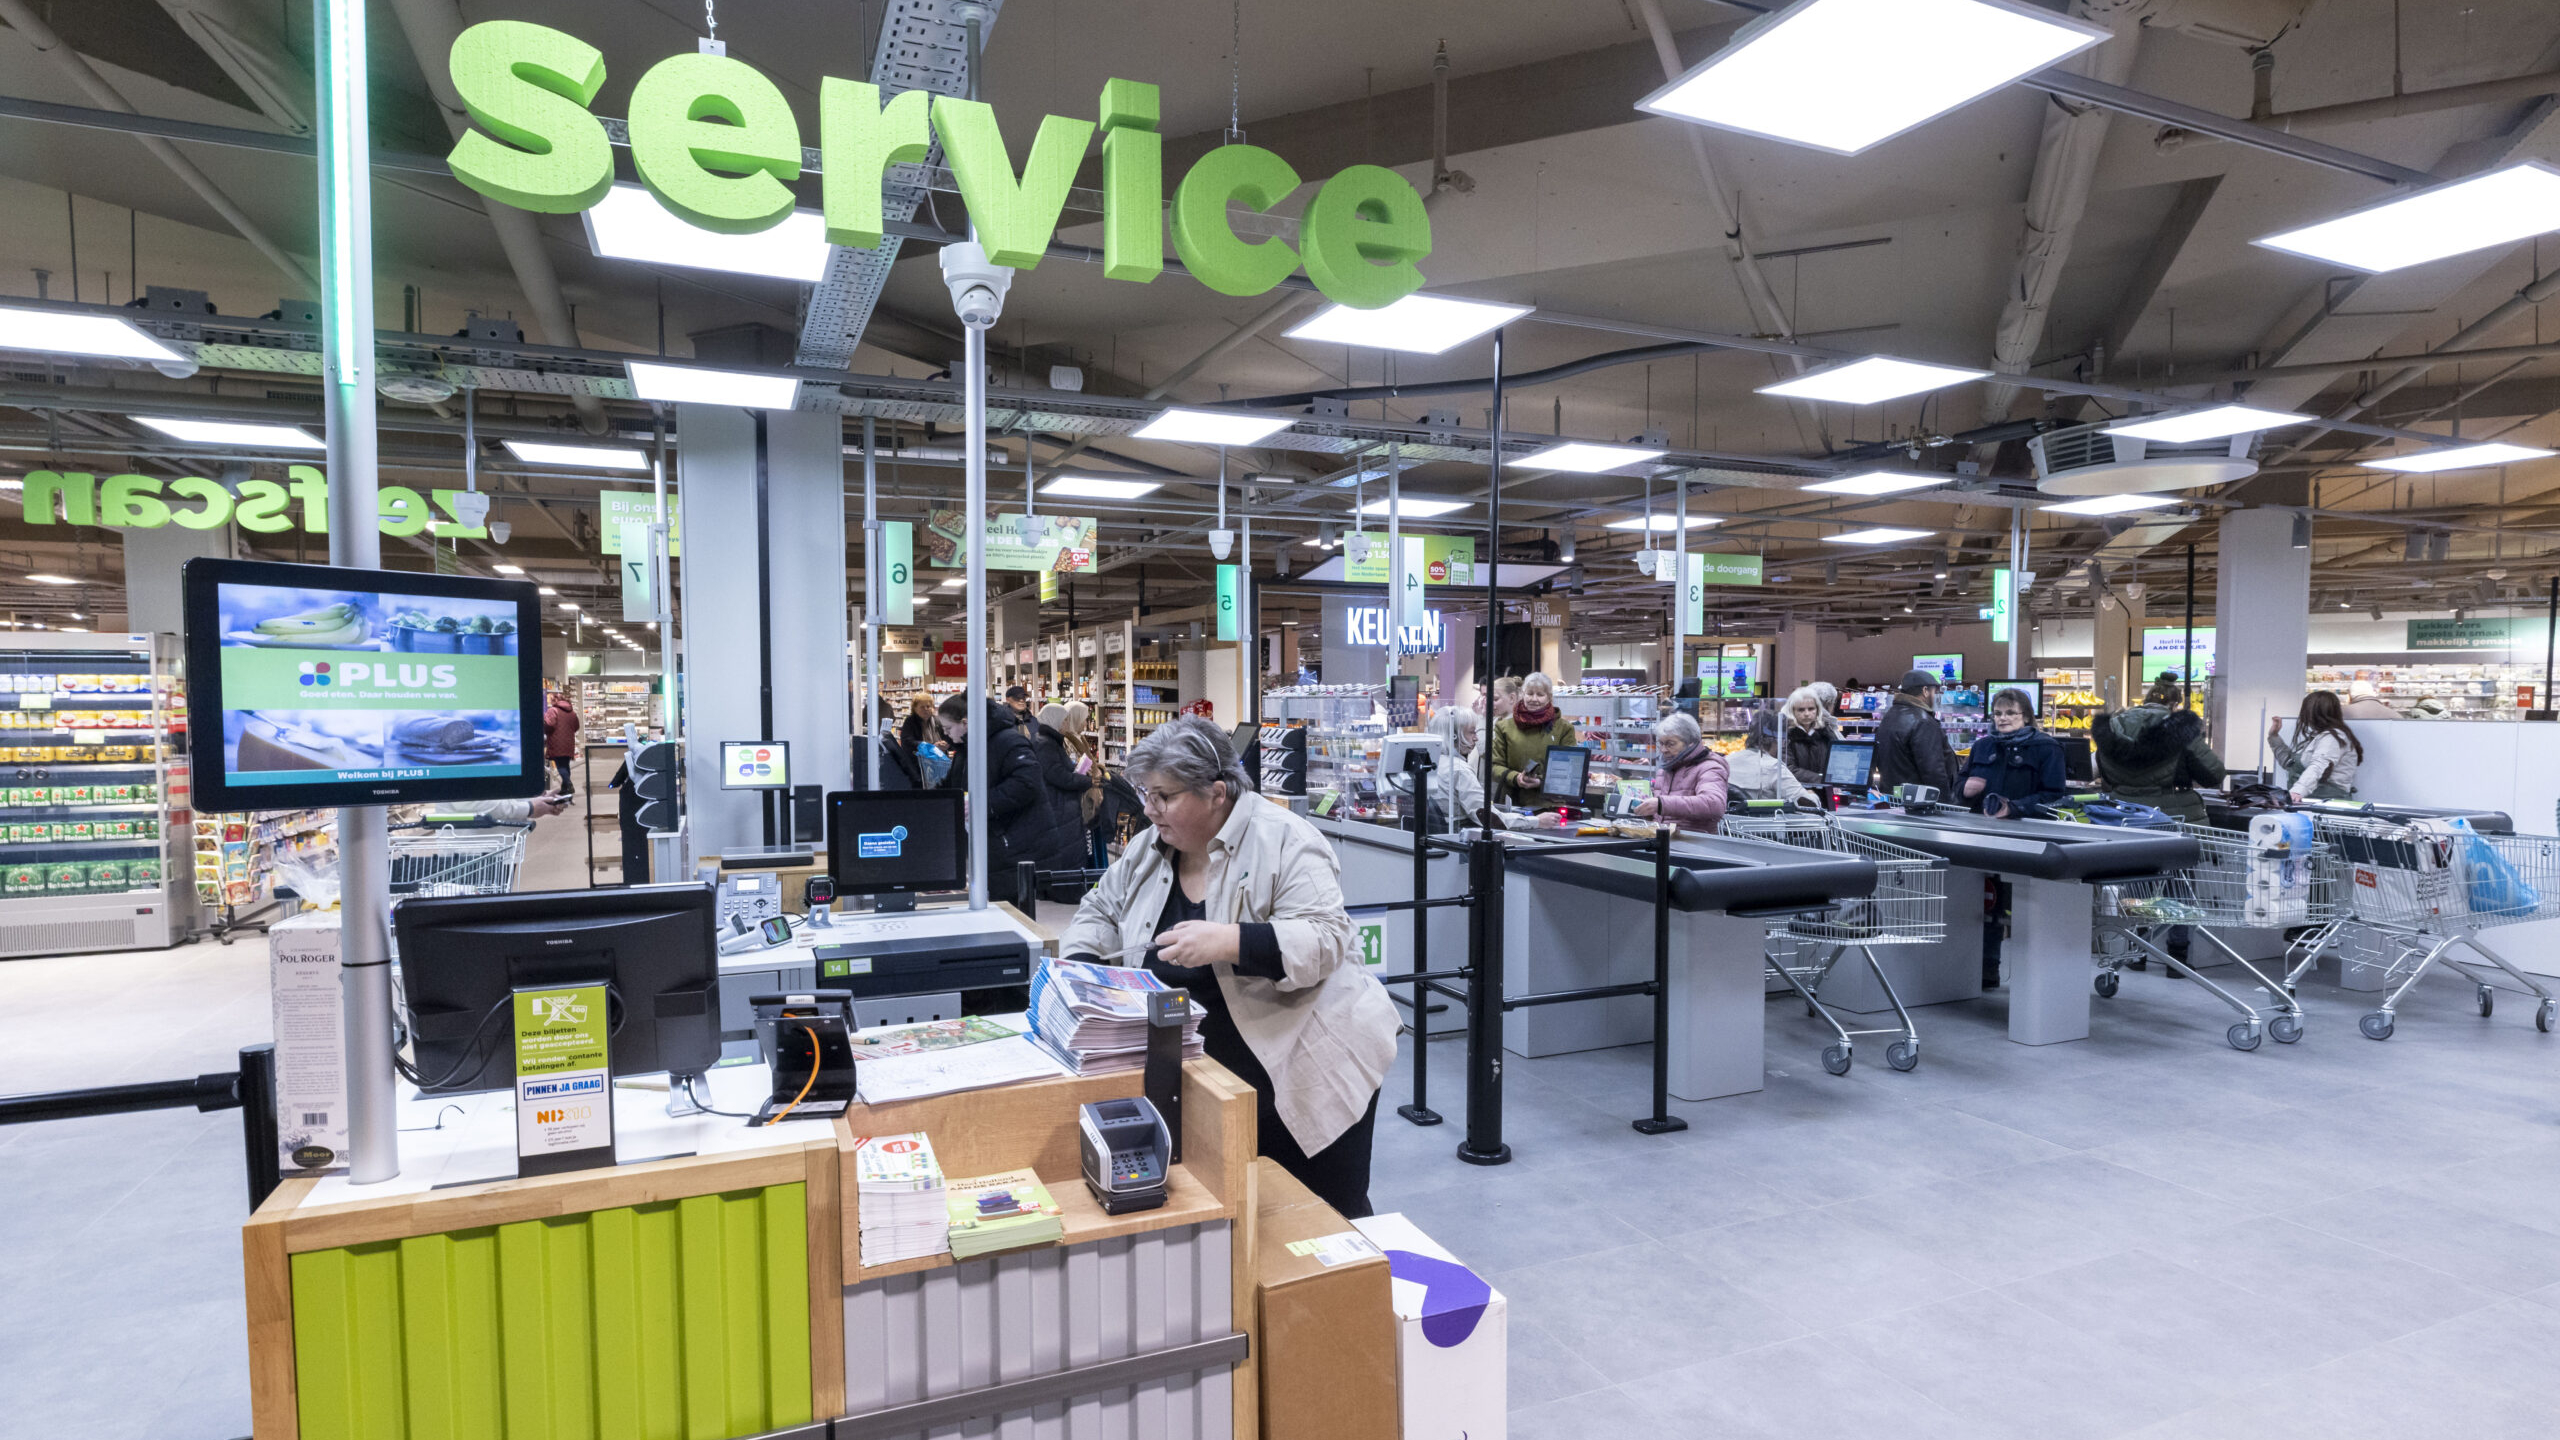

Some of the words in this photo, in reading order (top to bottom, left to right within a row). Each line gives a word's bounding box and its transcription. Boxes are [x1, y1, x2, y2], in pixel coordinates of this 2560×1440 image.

[447, 20, 1433, 310] service
[612, 501, 629, 513] Bij
[986, 525, 1003, 534] eel
[1717, 564, 1758, 577] doorgang
[1534, 602, 1549, 614] VERS
[1534, 614, 1561, 627] GEMAAKT
[1347, 607, 1440, 647] KEUEN
[2417, 622, 2454, 630] Lekker
[2417, 631, 2453, 639] groots
[2416, 639, 2469, 647] makkelijk
[940, 654, 968, 666] ACT
[339, 662, 457, 688] PLUS
[300, 690, 328, 699] Goed
[331, 691, 357, 699] eten.
[359, 691, 383, 699] Daar
[338, 771, 378, 780] Welkom
[381, 771, 394, 779] bij
[397, 770, 424, 778] PLUS
[280, 954, 299, 963] POL
[301, 954, 335, 963] ROGER
[830, 964, 841, 972] 14
[544, 1027, 577, 1035] biljetten
[522, 1035, 552, 1043] worden
[540, 1038, 595, 1049] geaccepteerd.
[568, 1052, 603, 1060] contante
[522, 1062, 565, 1072] betalingen
[527, 1084, 557, 1095] PINNEN
[560, 1083, 570, 1092] JA
[572, 1080, 600, 1090] GRAAG
